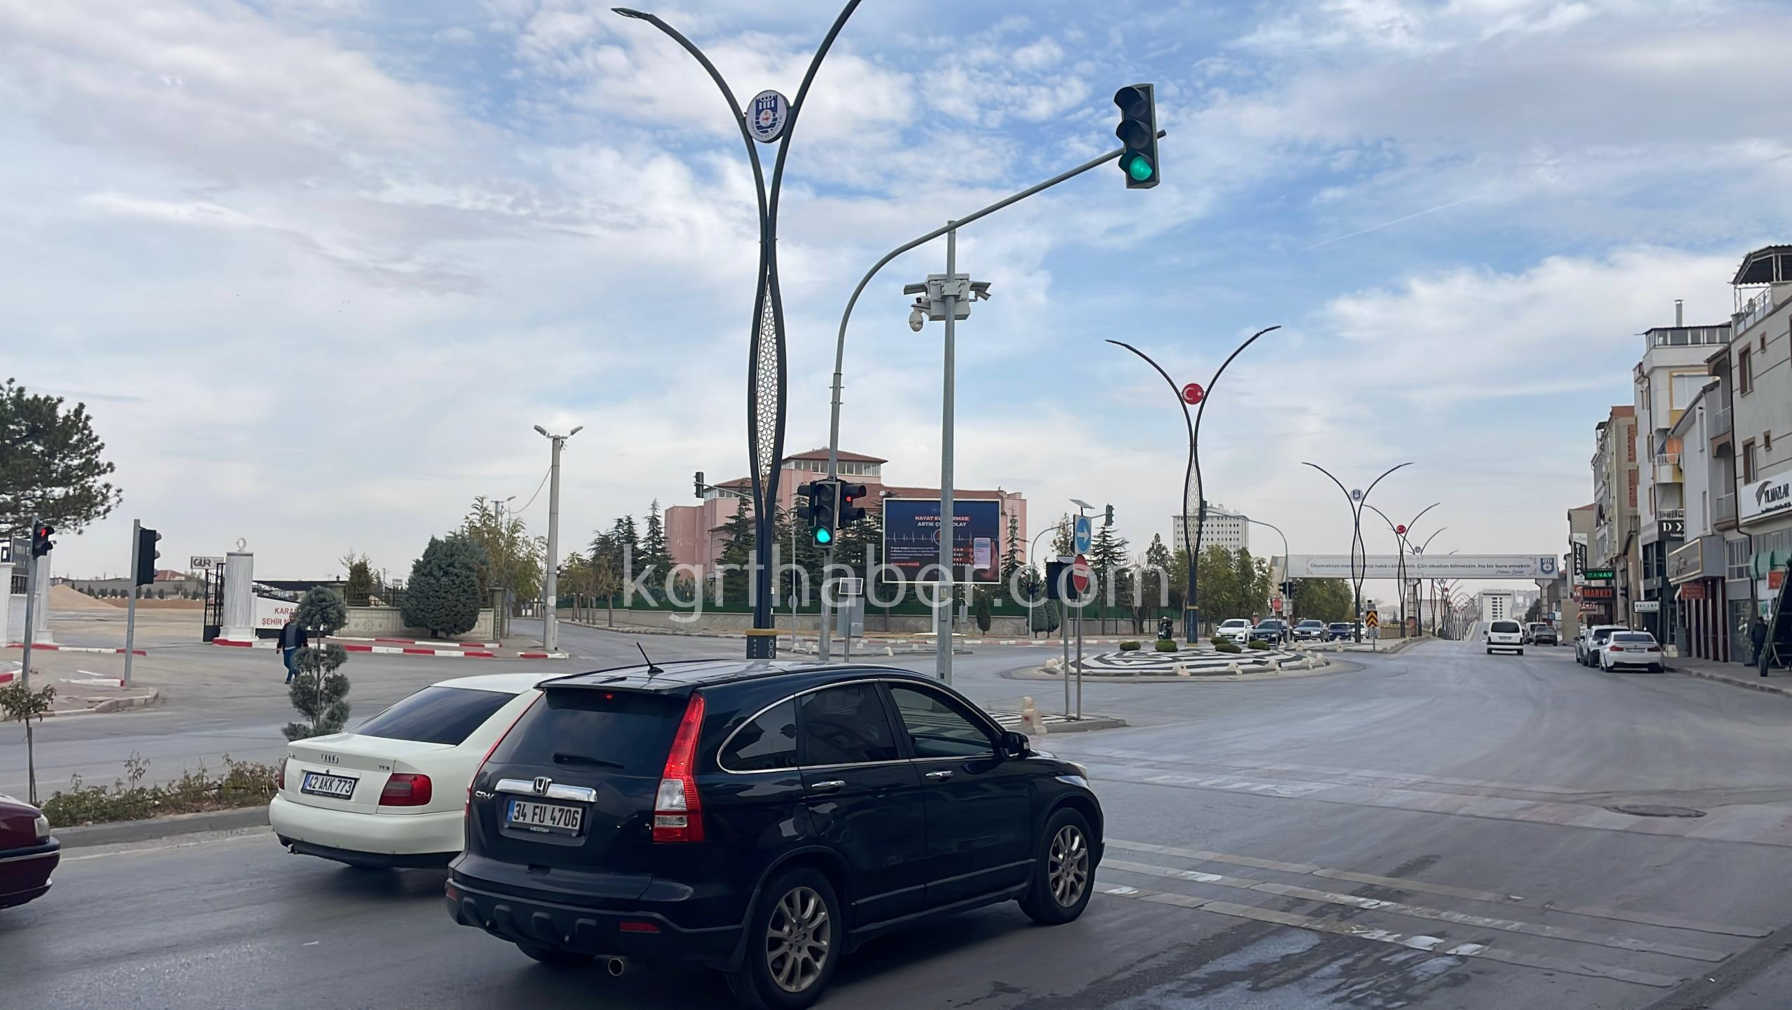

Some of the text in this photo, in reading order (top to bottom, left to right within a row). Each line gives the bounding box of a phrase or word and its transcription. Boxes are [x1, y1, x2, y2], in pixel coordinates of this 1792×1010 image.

[309, 776, 353, 793] 42 AKK 773
[514, 803, 580, 828] 34 FU 4706
